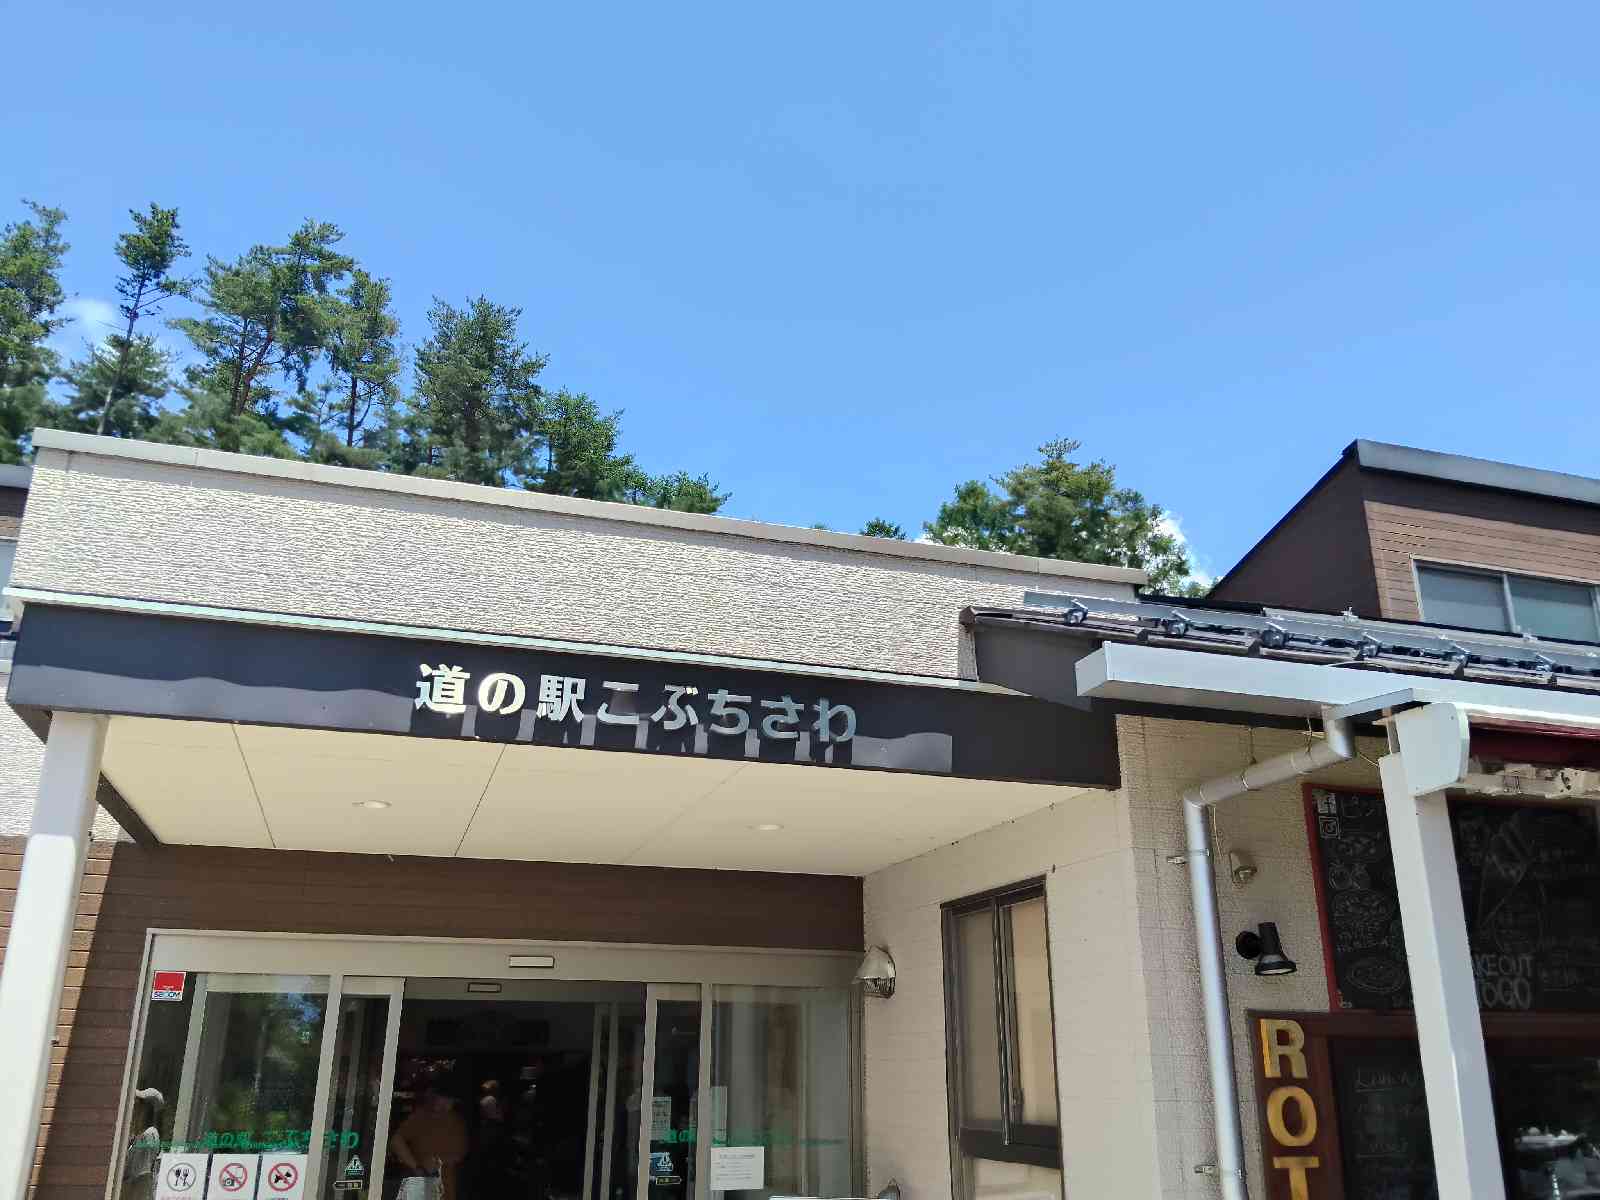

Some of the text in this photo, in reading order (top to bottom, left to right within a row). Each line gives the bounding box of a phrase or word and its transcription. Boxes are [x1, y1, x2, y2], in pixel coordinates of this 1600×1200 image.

[414, 663, 858, 743] 道の駅こぶちさわ
